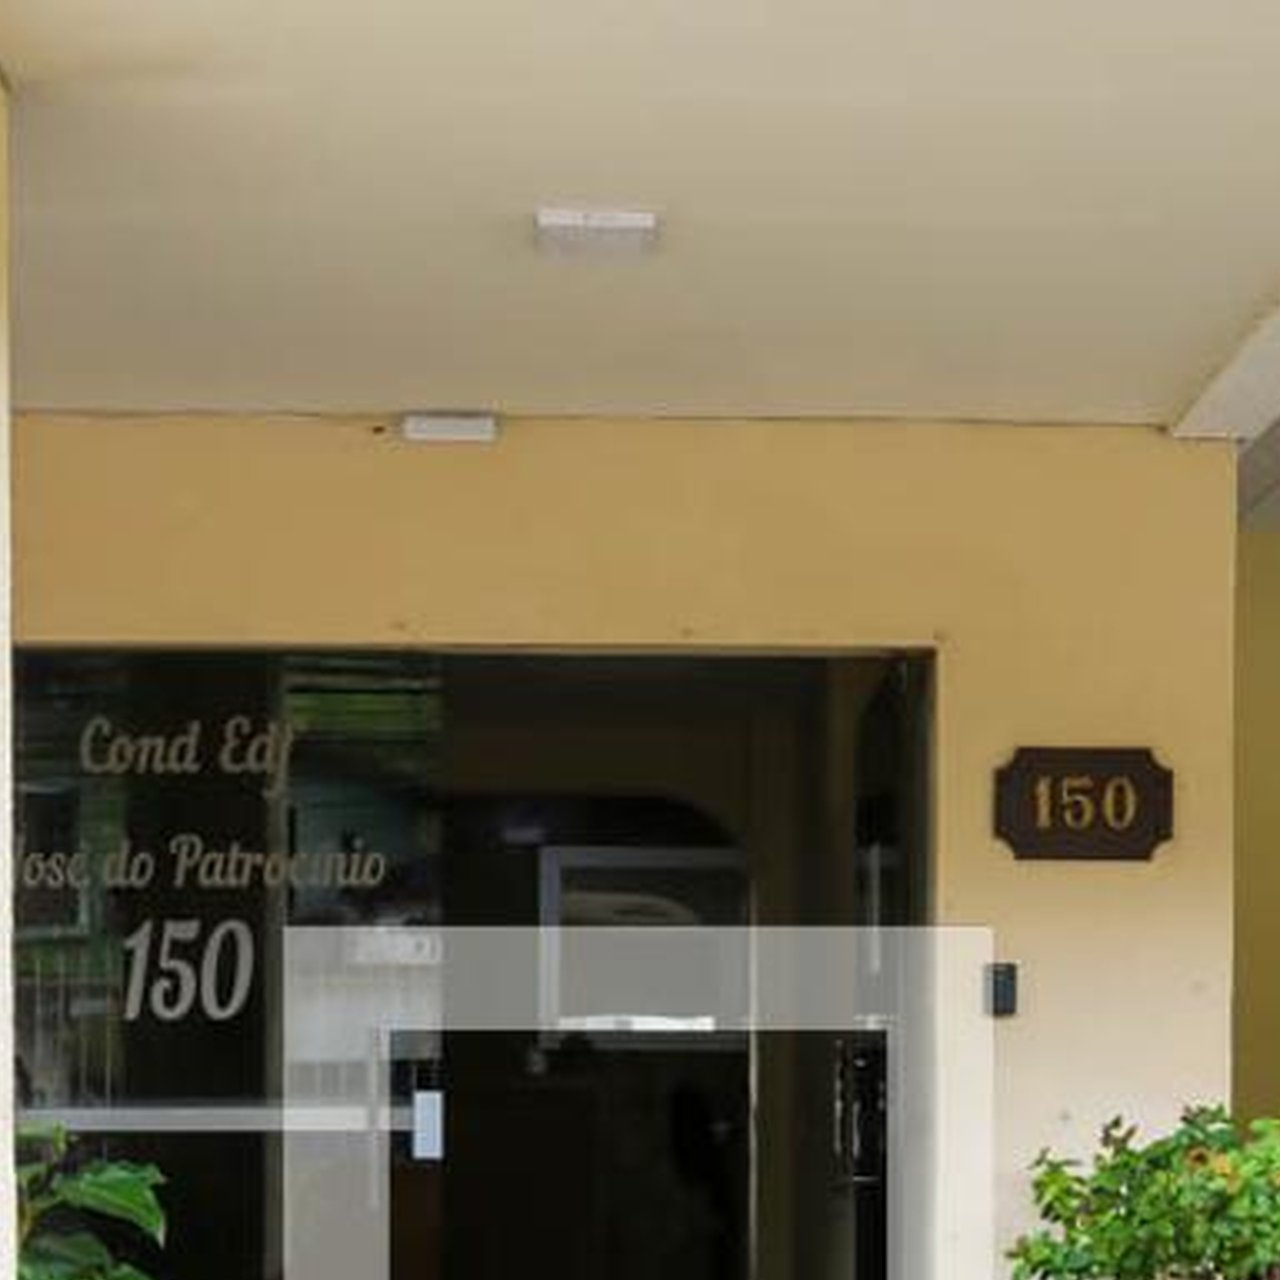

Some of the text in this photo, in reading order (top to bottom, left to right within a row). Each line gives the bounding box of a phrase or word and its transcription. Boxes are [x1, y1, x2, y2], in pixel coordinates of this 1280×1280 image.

[79, 713, 202, 775] Cond
[1034, 775, 1137, 831] 150
[102, 838, 155, 889] do
[122, 918, 256, 1022] 150
